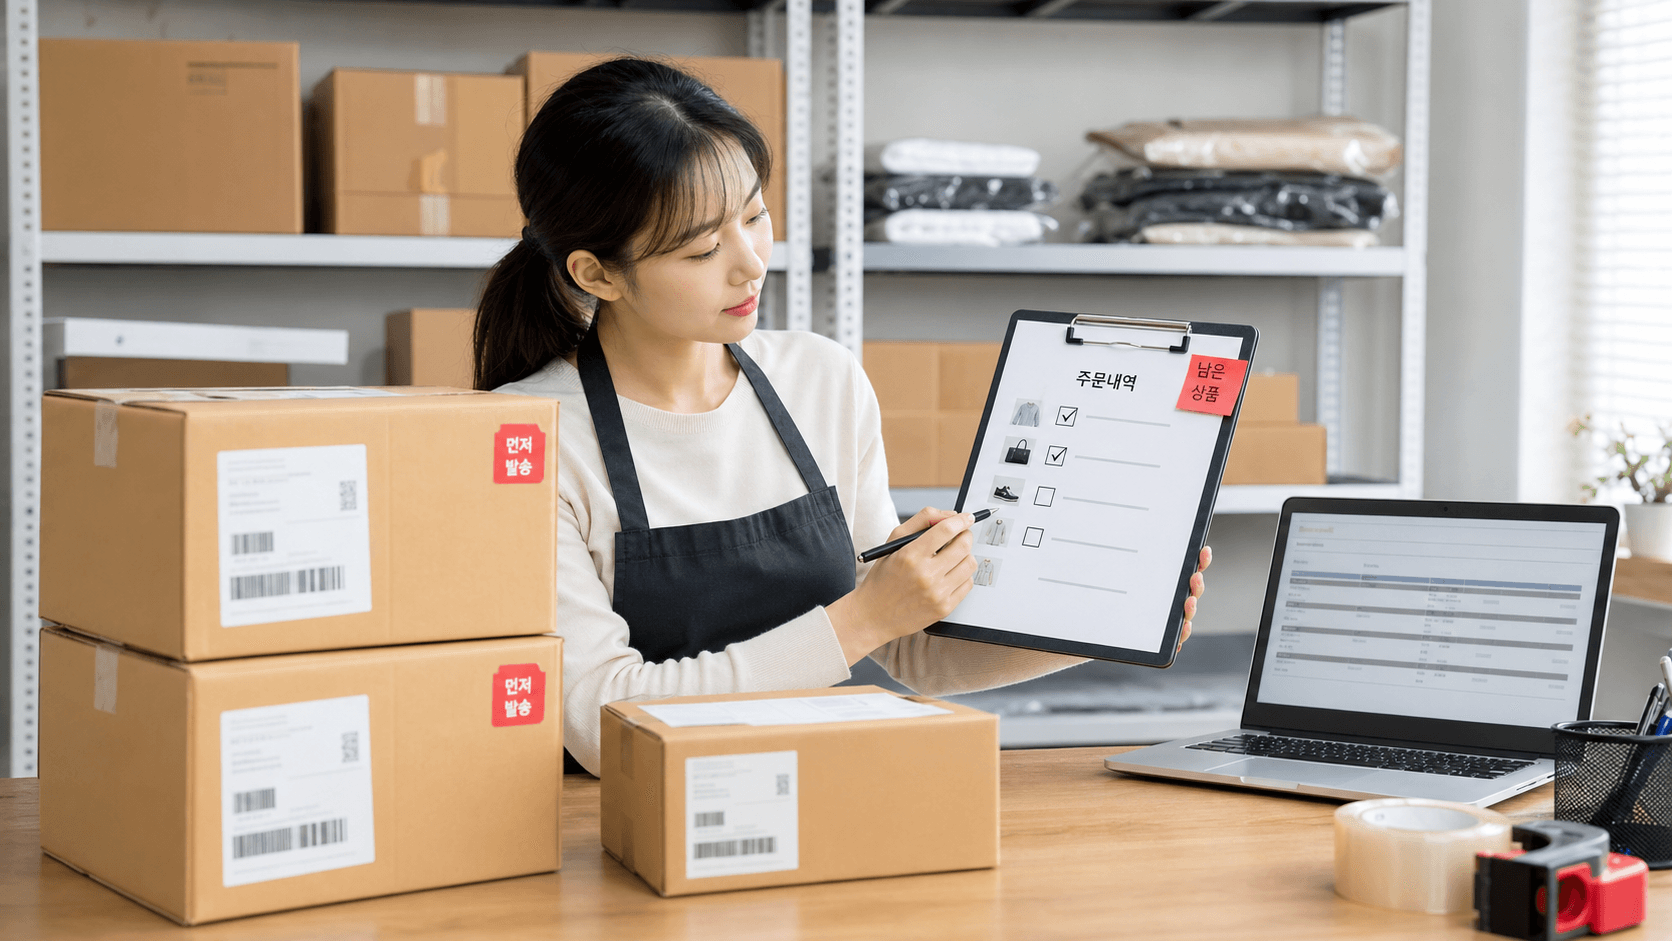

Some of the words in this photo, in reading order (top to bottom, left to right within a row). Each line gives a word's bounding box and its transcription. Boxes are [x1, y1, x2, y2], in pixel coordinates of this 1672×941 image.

[1076, 370, 1138, 392] 주문내역
[1197, 362, 1226, 381] 남은
[1191, 384, 1220, 403] 상품
[506, 436, 533, 454] 먼저
[505, 458, 533, 477] 발송
[505, 676, 532, 696] 먼저
[505, 698, 532, 718] 발송
